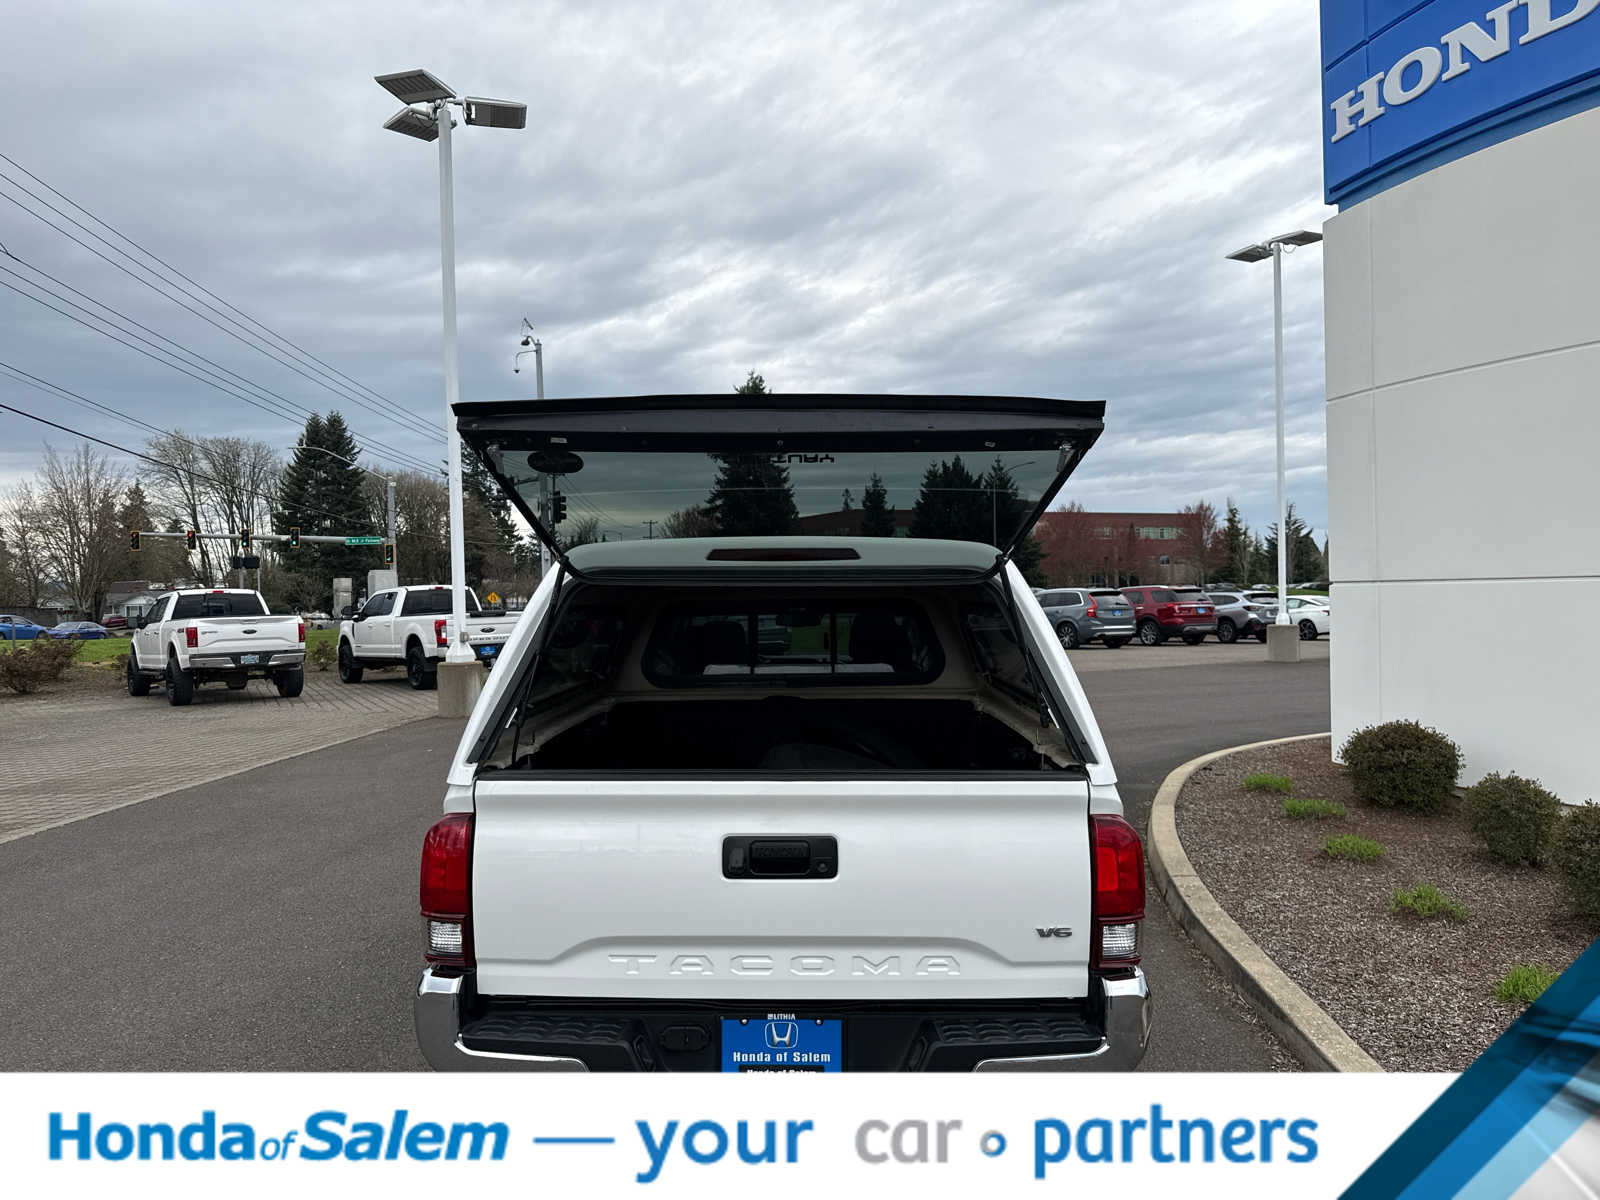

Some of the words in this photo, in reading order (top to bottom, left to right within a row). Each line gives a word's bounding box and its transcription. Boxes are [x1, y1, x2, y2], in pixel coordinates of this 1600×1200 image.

[1036, 926, 1073, 939] V6
[608, 954, 961, 976] TACOMA
[733, 1051, 771, 1062] Honda
[776, 1051, 788, 1062] of
[793, 1051, 831, 1062] Salem
